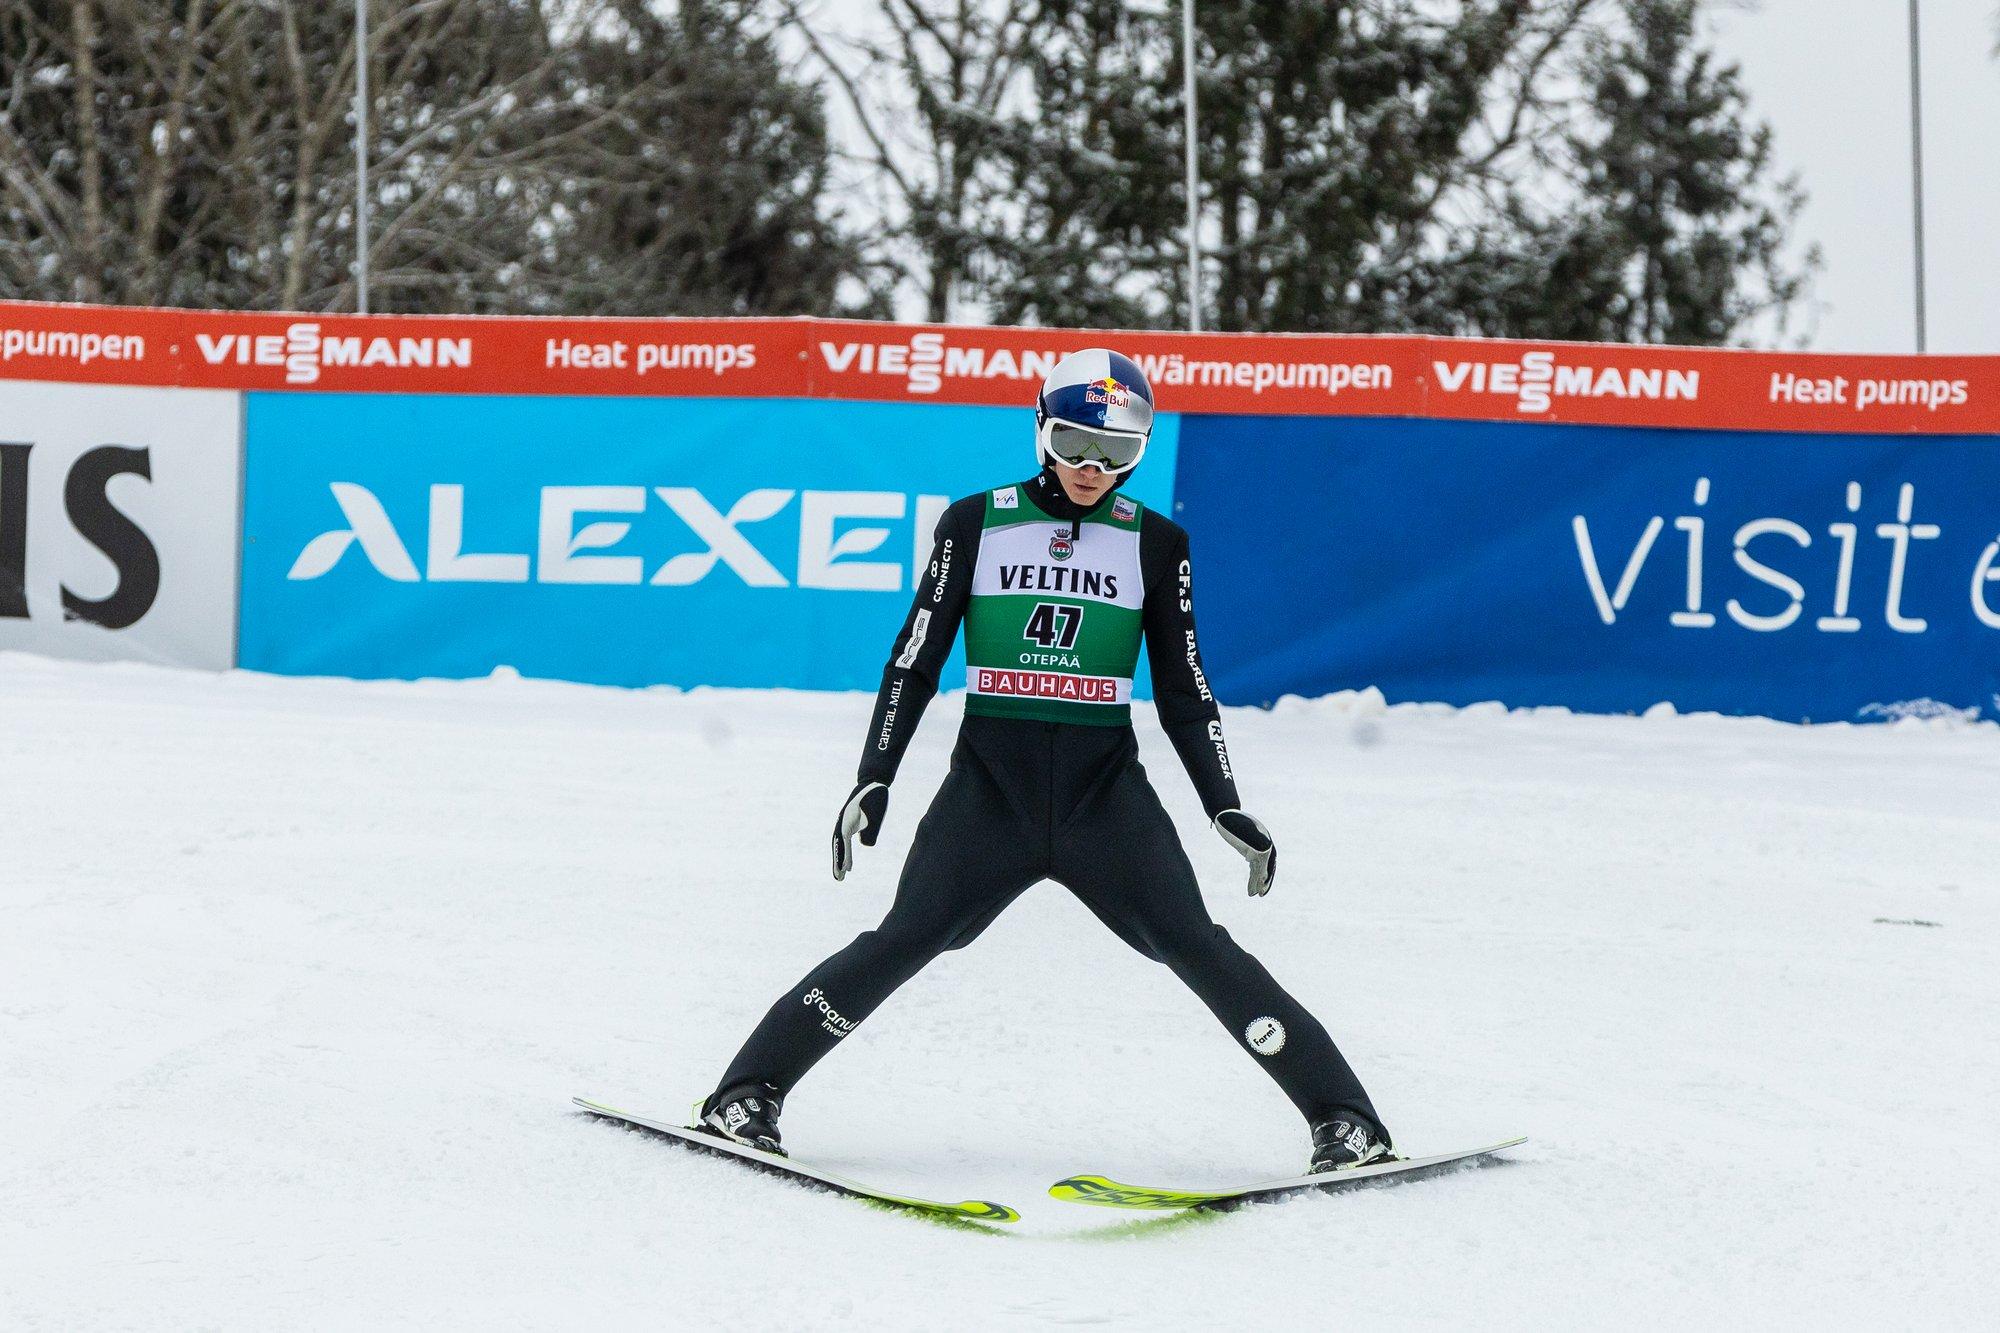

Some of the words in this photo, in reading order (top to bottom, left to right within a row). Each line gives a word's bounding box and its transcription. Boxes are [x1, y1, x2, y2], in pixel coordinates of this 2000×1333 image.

[0, 329, 145, 365] pumpen
[195, 323, 472, 384] VIESSMANN
[546, 338, 627, 370] Heat
[637, 340, 756, 375] pumps
[819, 333, 1074, 394] VIESSMAN
[1133, 353, 1392, 396] Wärmepumpen
[1433, 351, 1700, 413] VIESSMANN
[1769, 372, 1848, 405] Heat
[1856, 376, 1968, 411] pumps
[1086, 391, 1108, 404] Red
[1109, 395, 1129, 408] Bull
[933, 539, 953, 602] CONNECTO
[1572, 477, 1941, 633] visit
[999, 565, 1119, 600] VELTINS
[1023, 602, 1084, 650] 47
[1019, 653, 1081, 669] OTEPÄÄ
[1185, 629, 1212, 702] RAMIRENT
[889, 678, 904, 706] MILL
[980, 673, 1116, 699] BAUHAUS
[1214, 741, 1233, 780] KIOSK
